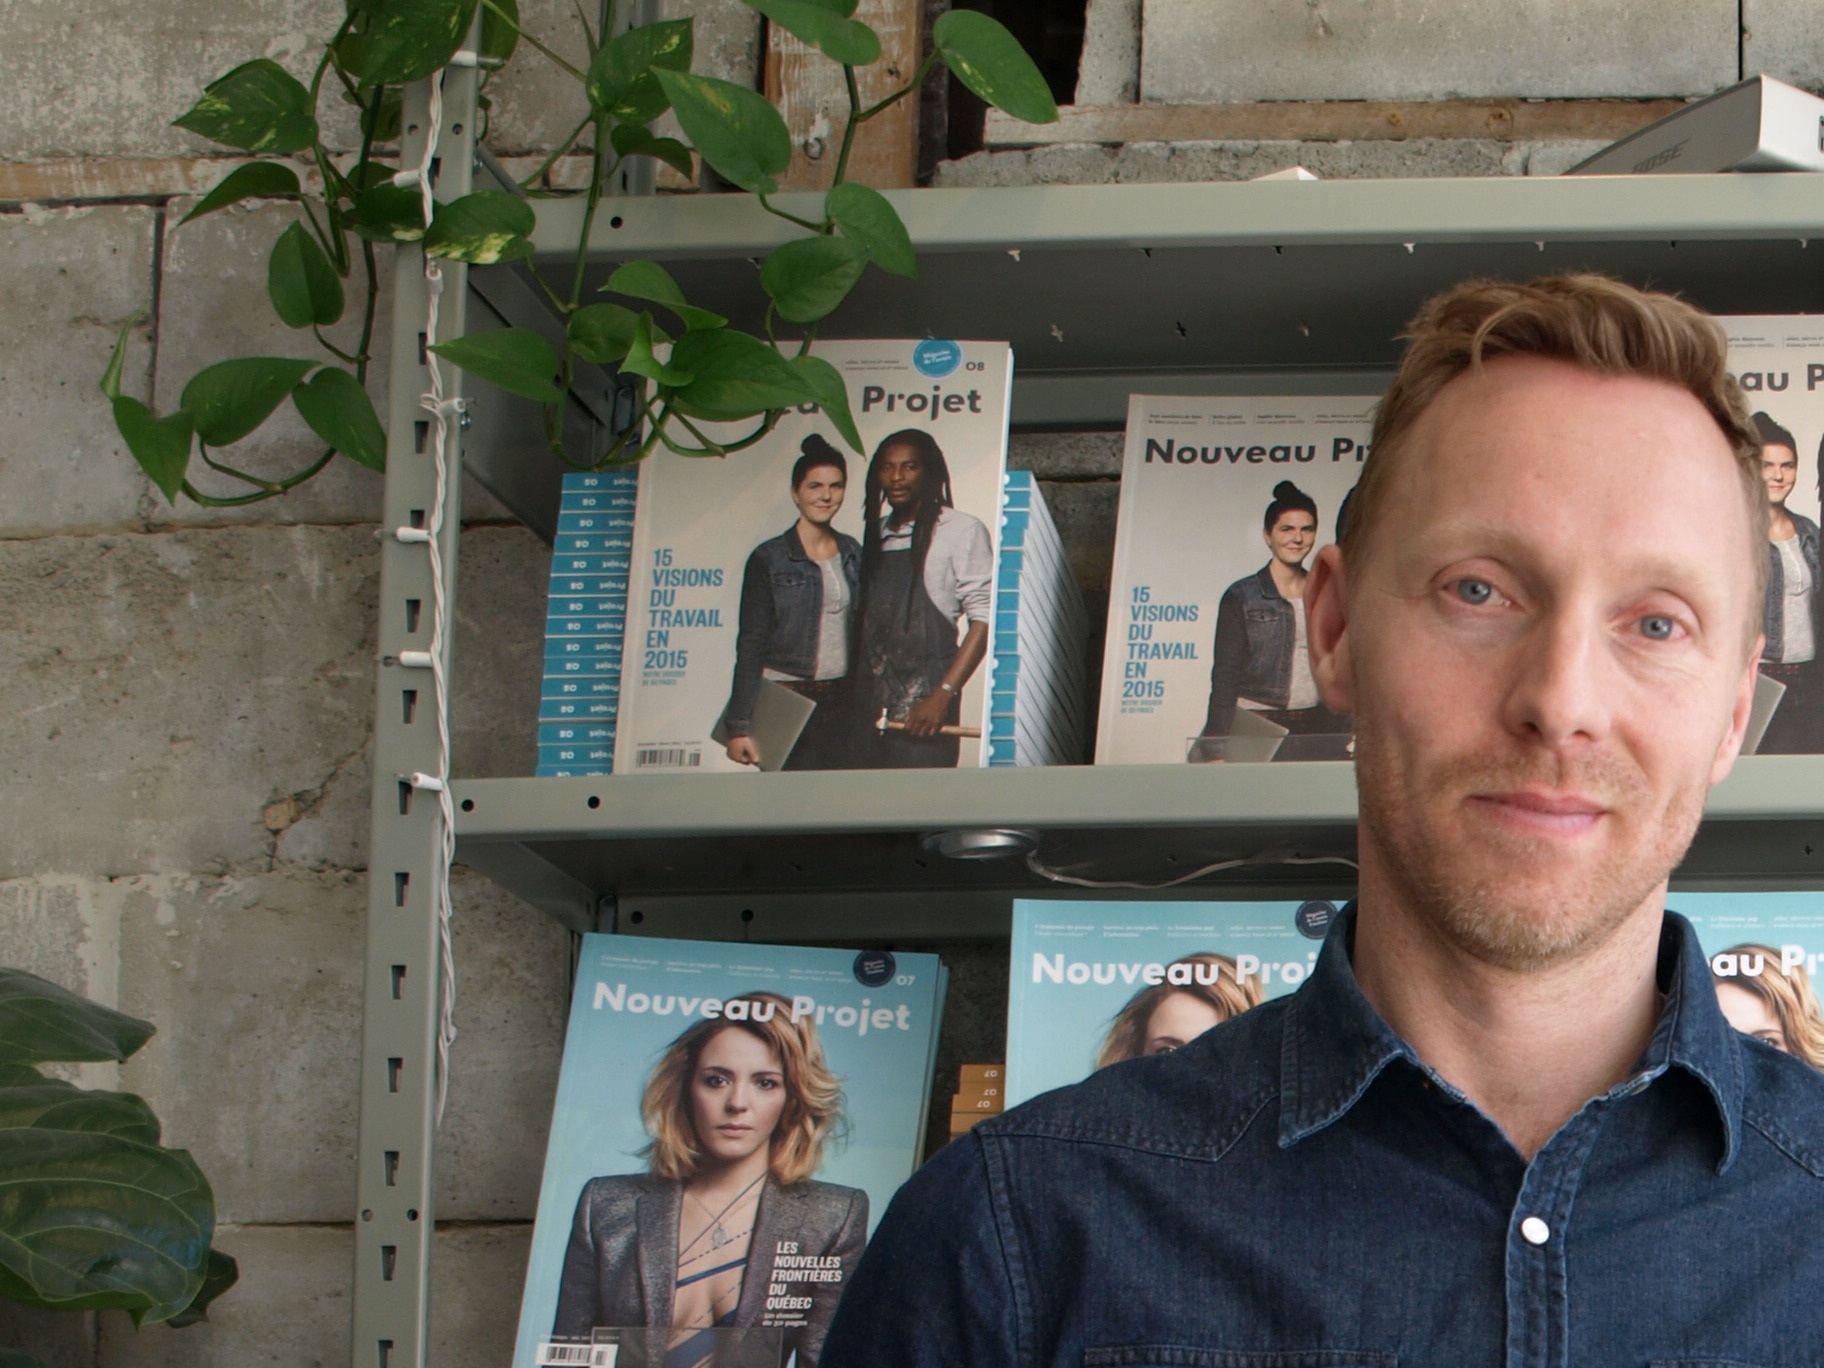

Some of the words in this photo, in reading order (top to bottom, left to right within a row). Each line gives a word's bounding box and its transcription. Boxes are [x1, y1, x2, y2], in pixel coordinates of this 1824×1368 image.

[965, 360, 985, 372] 08
[862, 384, 982, 421] Projet
[1144, 437, 1317, 465] Nouveau
[655, 549, 673, 567] 15
[652, 568, 724, 588] VISIONS
[650, 589, 676, 607] DU
[1132, 586, 1151, 603] 15
[649, 609, 724, 628] TRAVAIL
[1130, 604, 1200, 622] VISIONS
[647, 629, 670, 648] EN
[1128, 623, 1153, 641] DU
[644, 650, 688, 669] 2015
[1127, 642, 1200, 660] TRAVAIL
[1125, 661, 1147, 679] EN
[1122, 680, 1165, 698] 2015
[1032, 951, 1220, 985] Nouveau
[895, 974, 916, 987] 07
[593, 981, 777, 1022] Nouveau
[790, 995, 912, 1036] Projet
[776, 1241, 799, 1255] LES
[773, 1255, 842, 1269] NOUVELLES
[771, 1268, 843, 1282] FRONTIÈRES
[769, 1283, 788, 1296] DU
[766, 1295, 813, 1311] QUÉBEC
